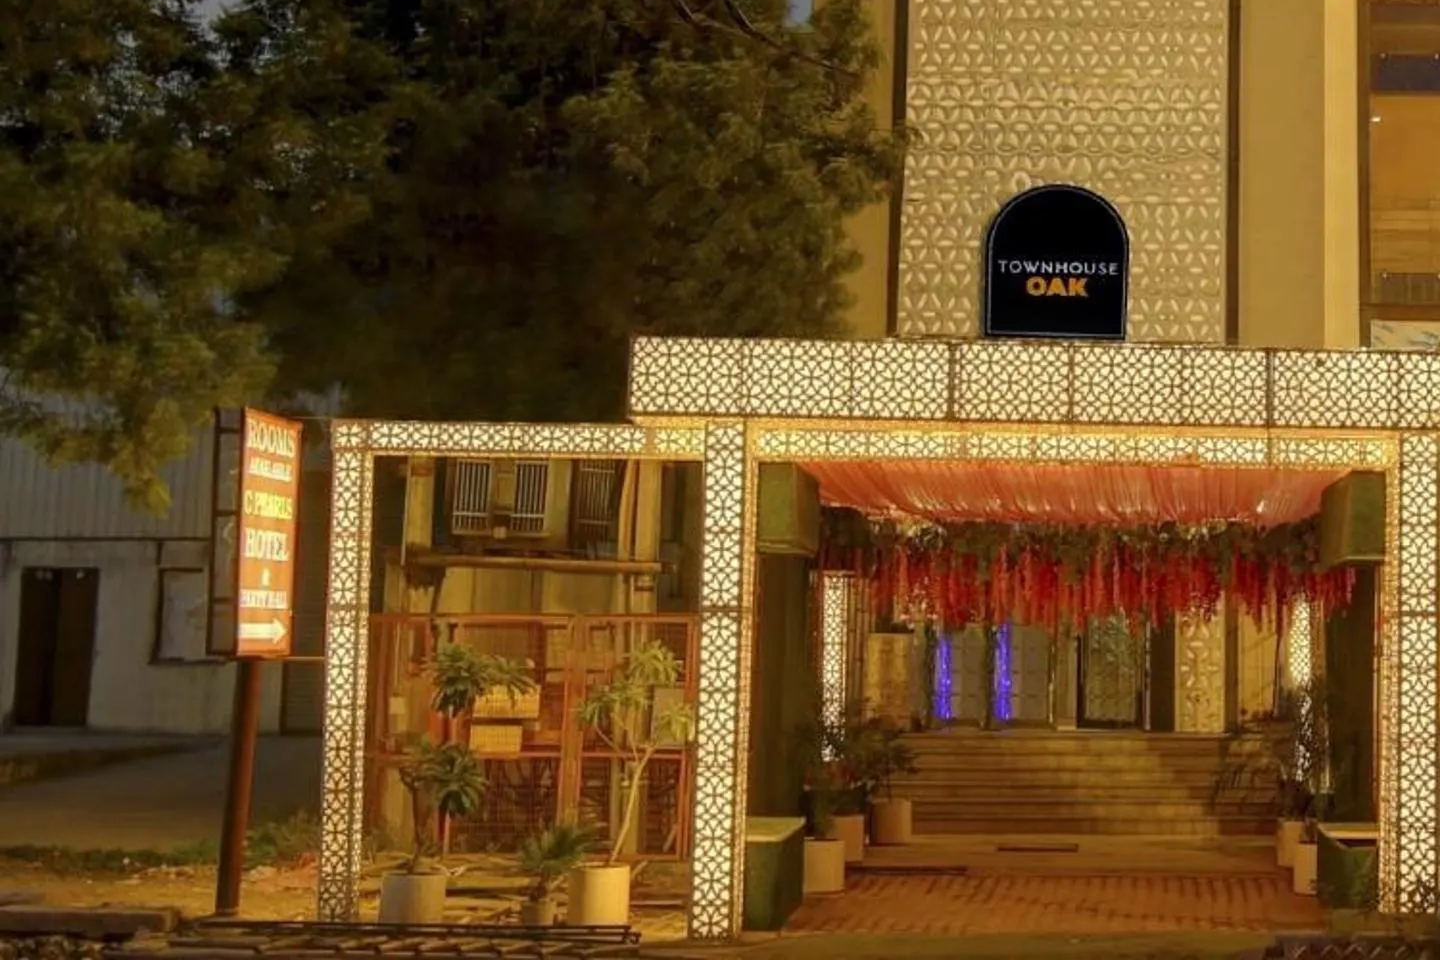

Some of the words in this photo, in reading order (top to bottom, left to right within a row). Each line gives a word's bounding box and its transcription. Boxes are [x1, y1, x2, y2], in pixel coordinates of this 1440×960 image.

[998, 260, 1120, 276] TOWNHOUSE
[1025, 276, 1089, 298] OAK
[247, 418, 296, 458] ROOMS
